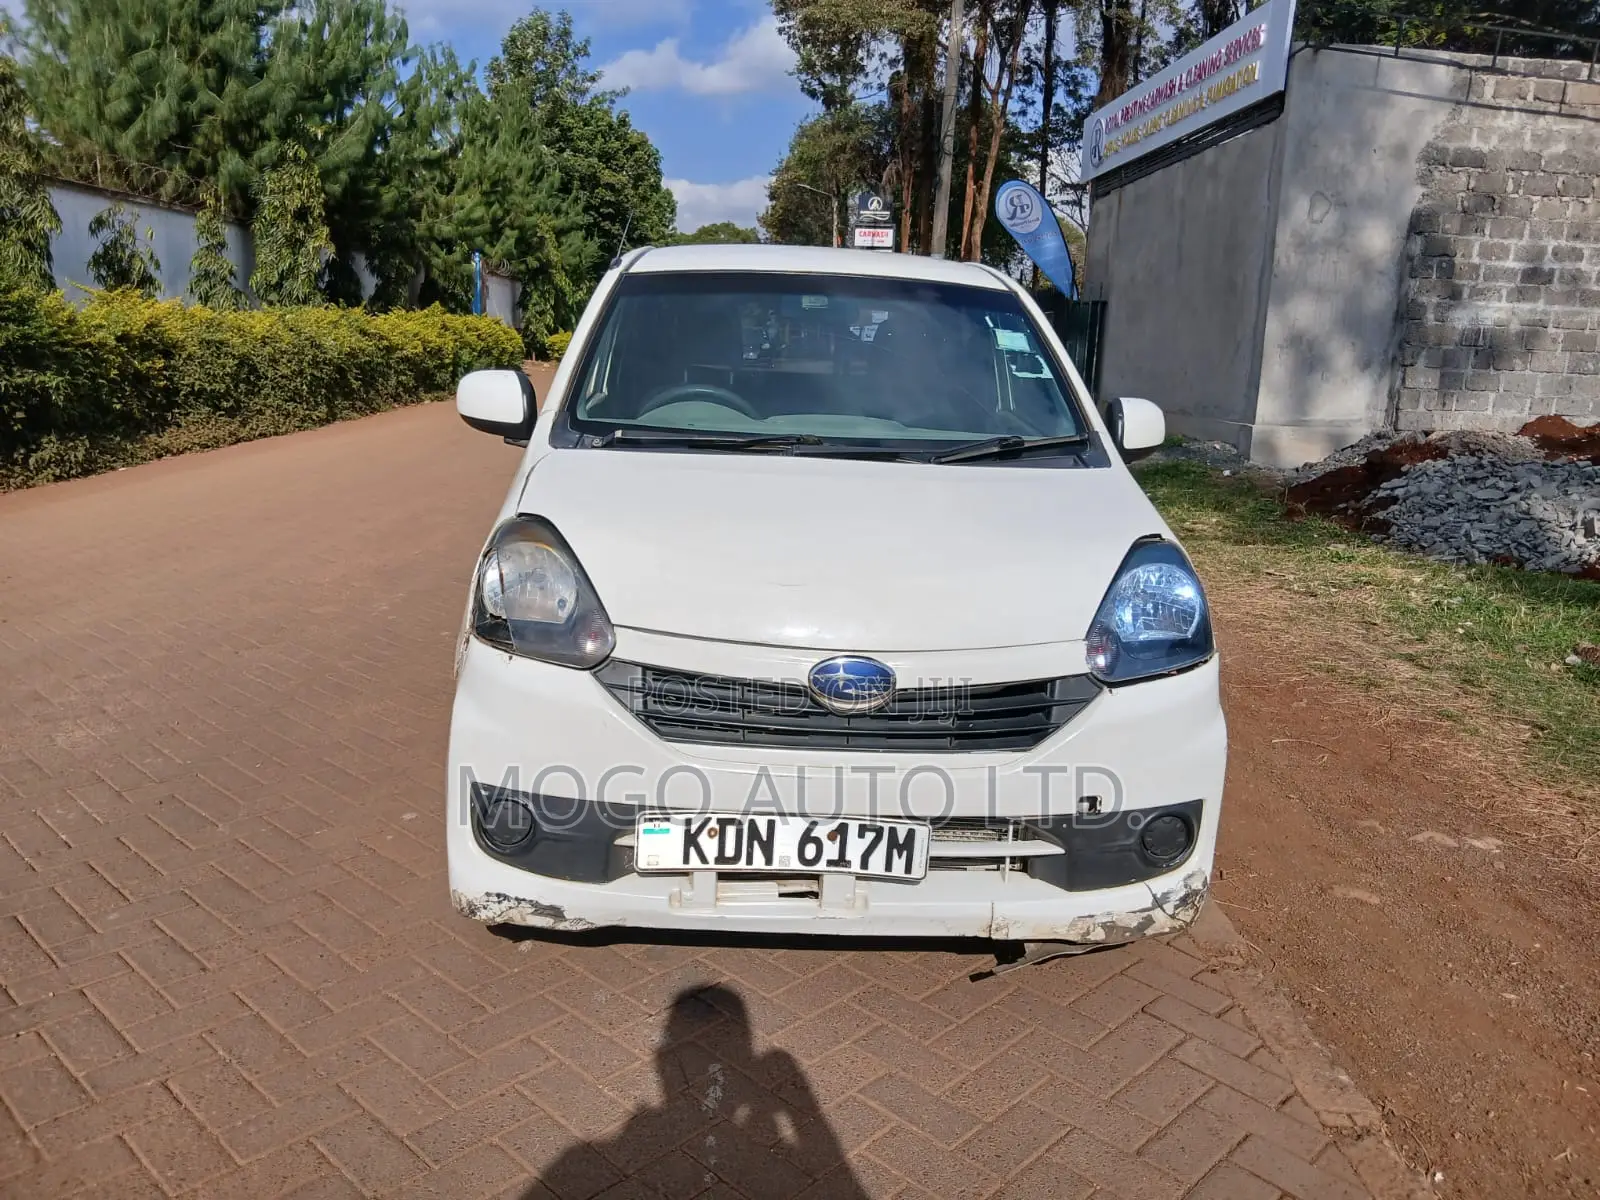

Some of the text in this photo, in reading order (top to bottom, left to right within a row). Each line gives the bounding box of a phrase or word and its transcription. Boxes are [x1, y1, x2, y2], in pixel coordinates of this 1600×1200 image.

[1147, 78, 1177, 110] CARWASH
[1178, 73, 1185, 92] &
[1186, 47, 1223, 88] CLEANING
[1224, 24, 1266, 66] SERVICES
[1208, 61, 1260, 103] FUMIGATION
[682, 816, 776, 867] KDN
[798, 819, 916, 875] 617M
